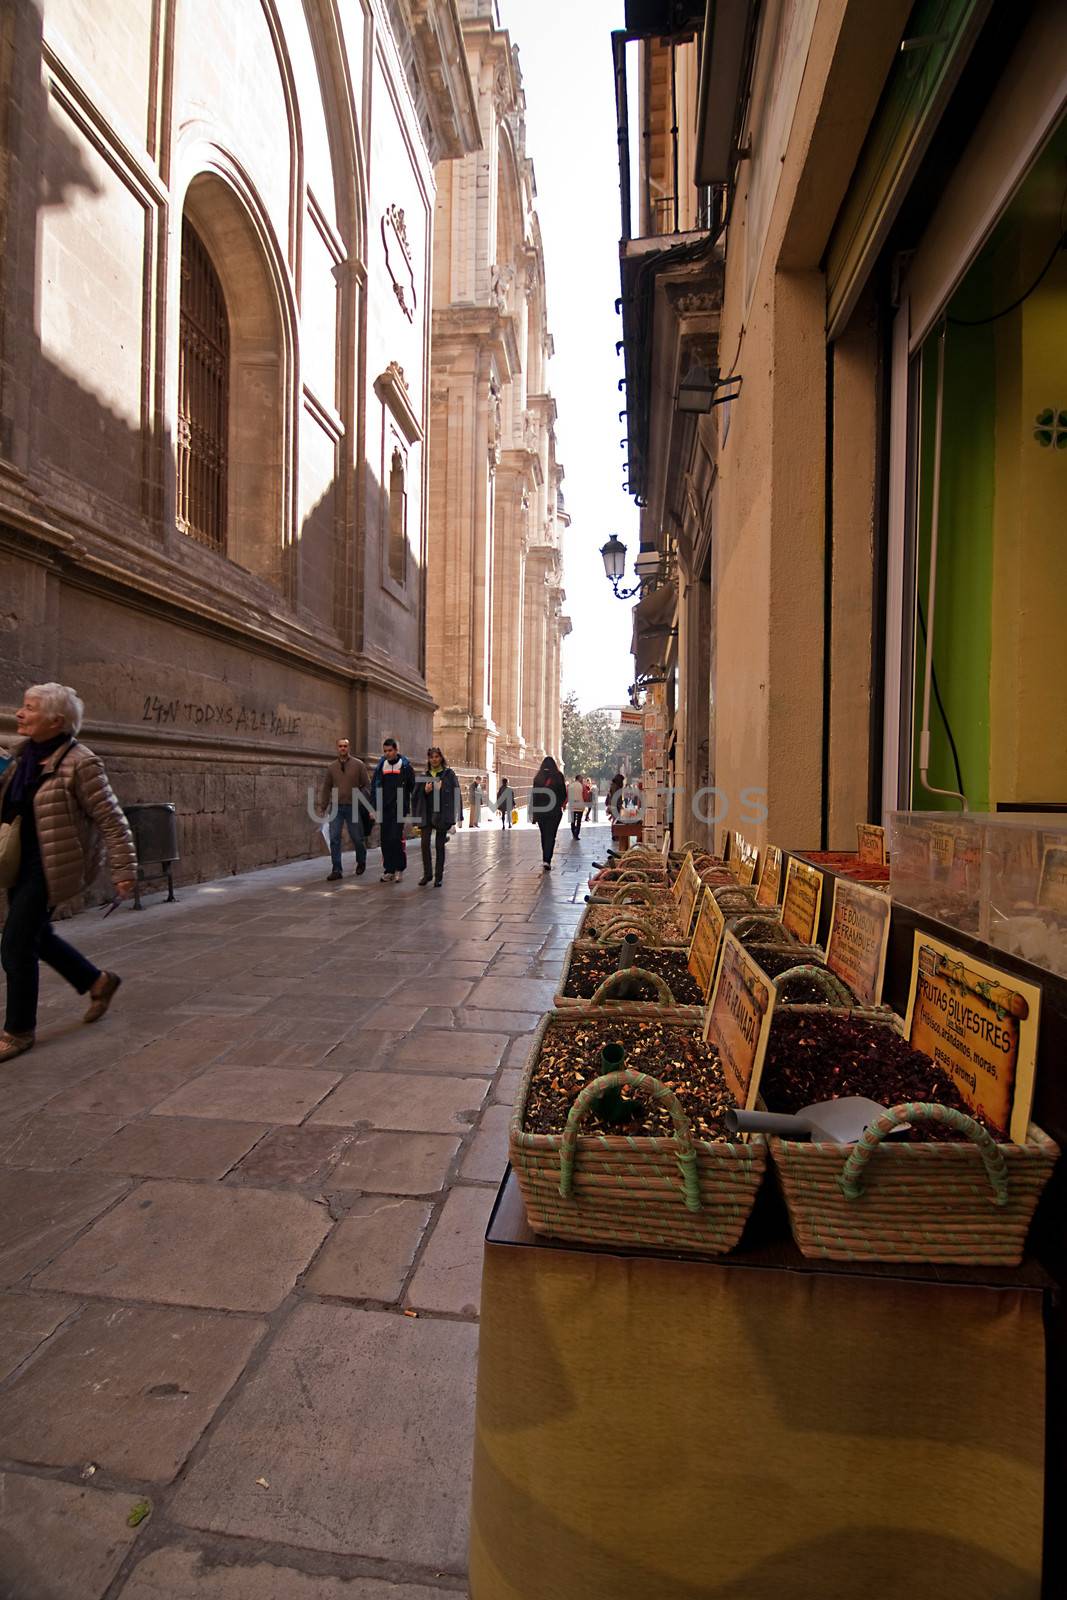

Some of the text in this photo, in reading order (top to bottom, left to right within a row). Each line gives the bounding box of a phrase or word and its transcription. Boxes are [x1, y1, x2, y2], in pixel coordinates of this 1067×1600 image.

[918, 978, 948, 1012] FRUTAS
[948, 998, 1011, 1054] SILVESTRES
[973, 1052, 998, 1080] moras,
